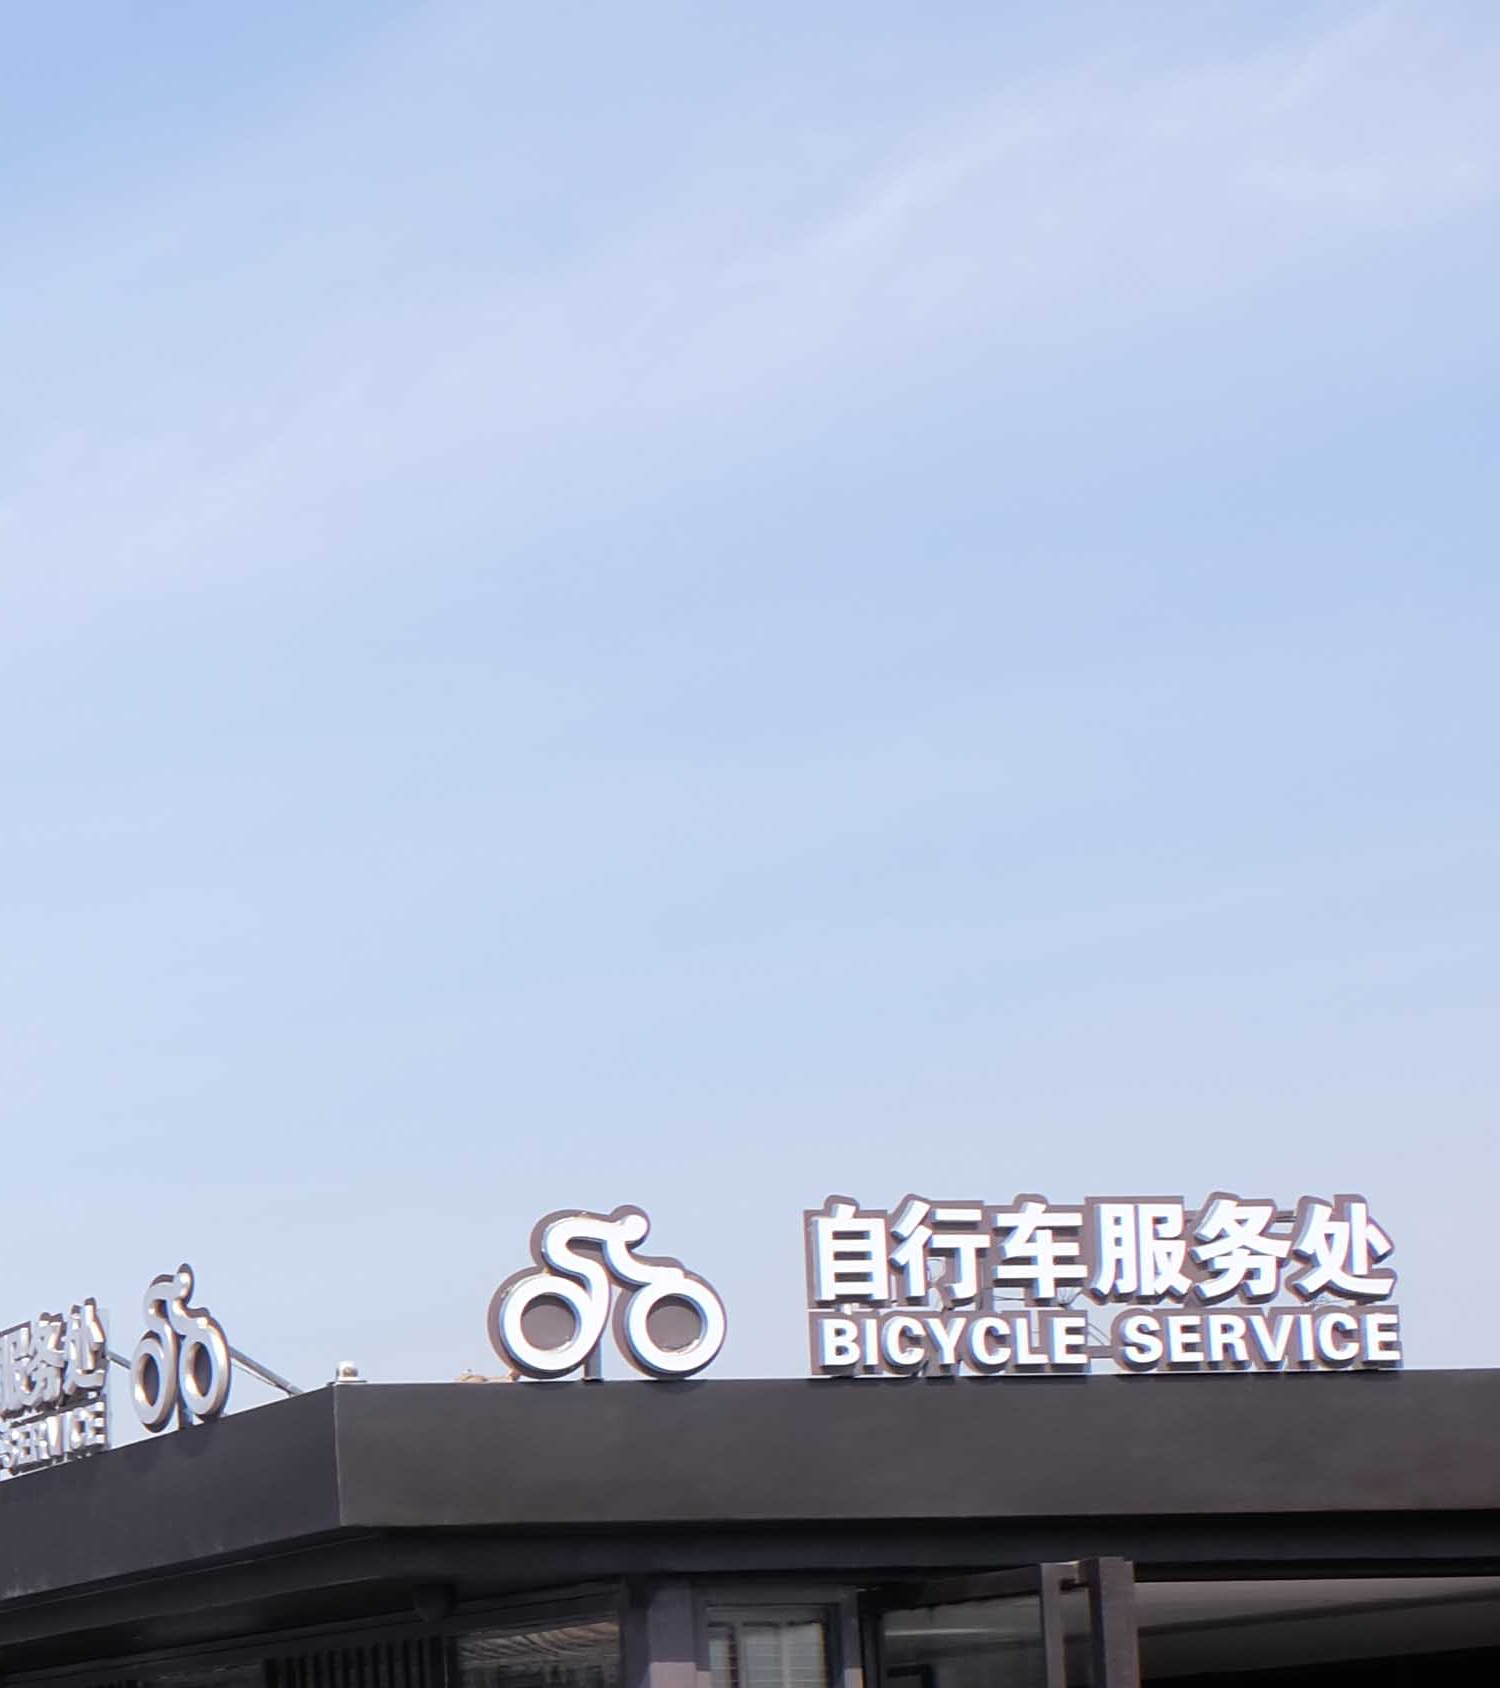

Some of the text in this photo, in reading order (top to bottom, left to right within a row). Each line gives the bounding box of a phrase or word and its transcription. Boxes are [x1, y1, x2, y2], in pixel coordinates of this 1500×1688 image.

[814, 1198, 1396, 1300] 自行车服务处
[819, 1311, 1401, 1368] BICYCLE SERVICE
